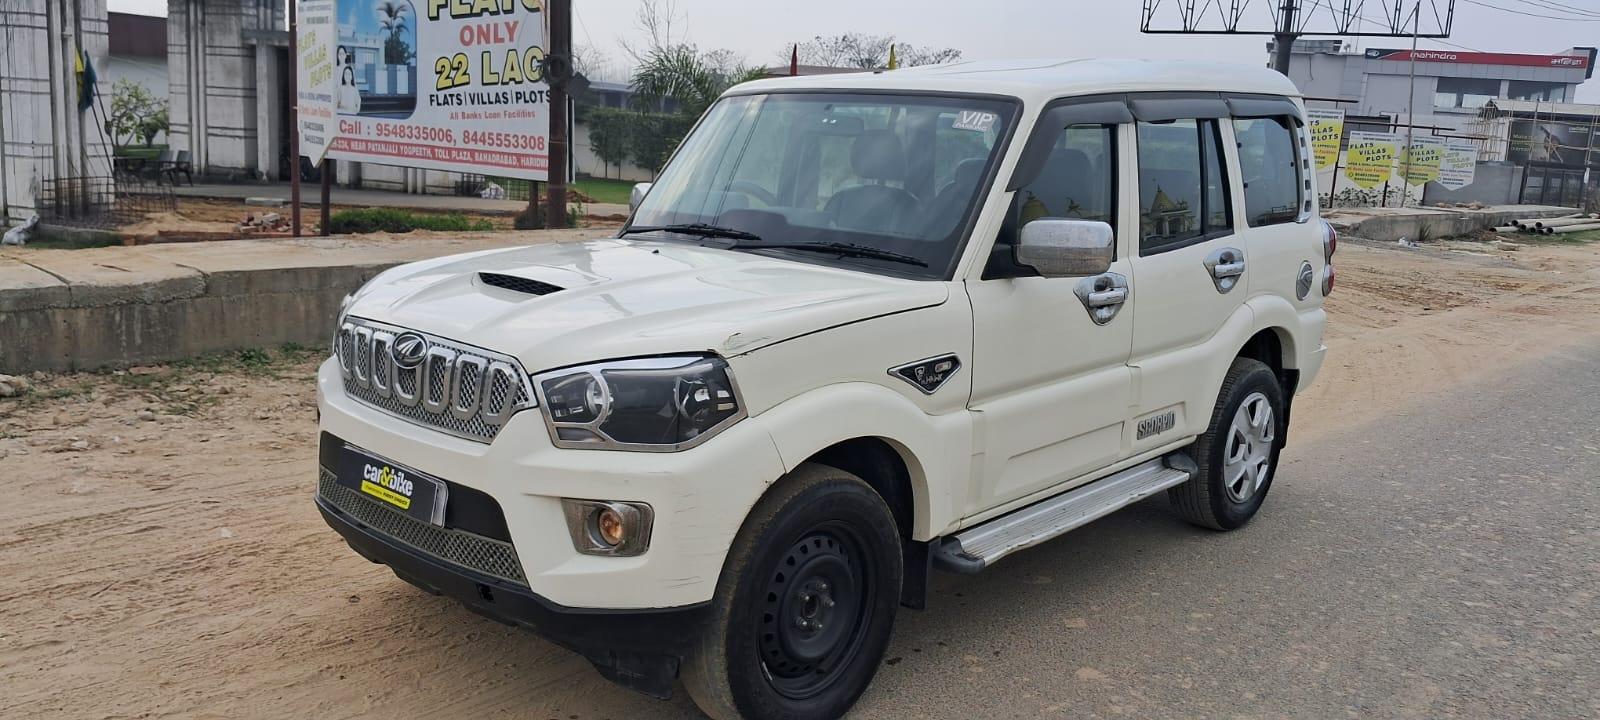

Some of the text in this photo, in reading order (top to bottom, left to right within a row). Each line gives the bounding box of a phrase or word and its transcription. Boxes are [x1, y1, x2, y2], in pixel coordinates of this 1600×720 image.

[459, 21, 519, 46] ONLY
[1410, 51, 1457, 60] mahindra
[435, 52, 470, 91] 22
[429, 93, 463, 106] FLATS
[468, 91, 509, 105] VILLAS
[450, 109, 536, 120] All Banks Loan Facilities
[963, 110, 993, 126] VIP
[340, 119, 362, 135] Call
[376, 122, 457, 146] 9548335006,
[463, 129, 545, 151] 8445553308
[1309, 126, 1334, 134] ILLAS
[1311, 133, 1339, 141] PLOTS
[367, 142, 398, 155] PATANJALI
[435, 148, 450, 160] TOLL
[451, 150, 473, 162] PLAZA,
[1358, 147, 1386, 155] VILLAS
[1365, 154, 1392, 162] PLOTS
[363, 463, 414, 497] car&bike
